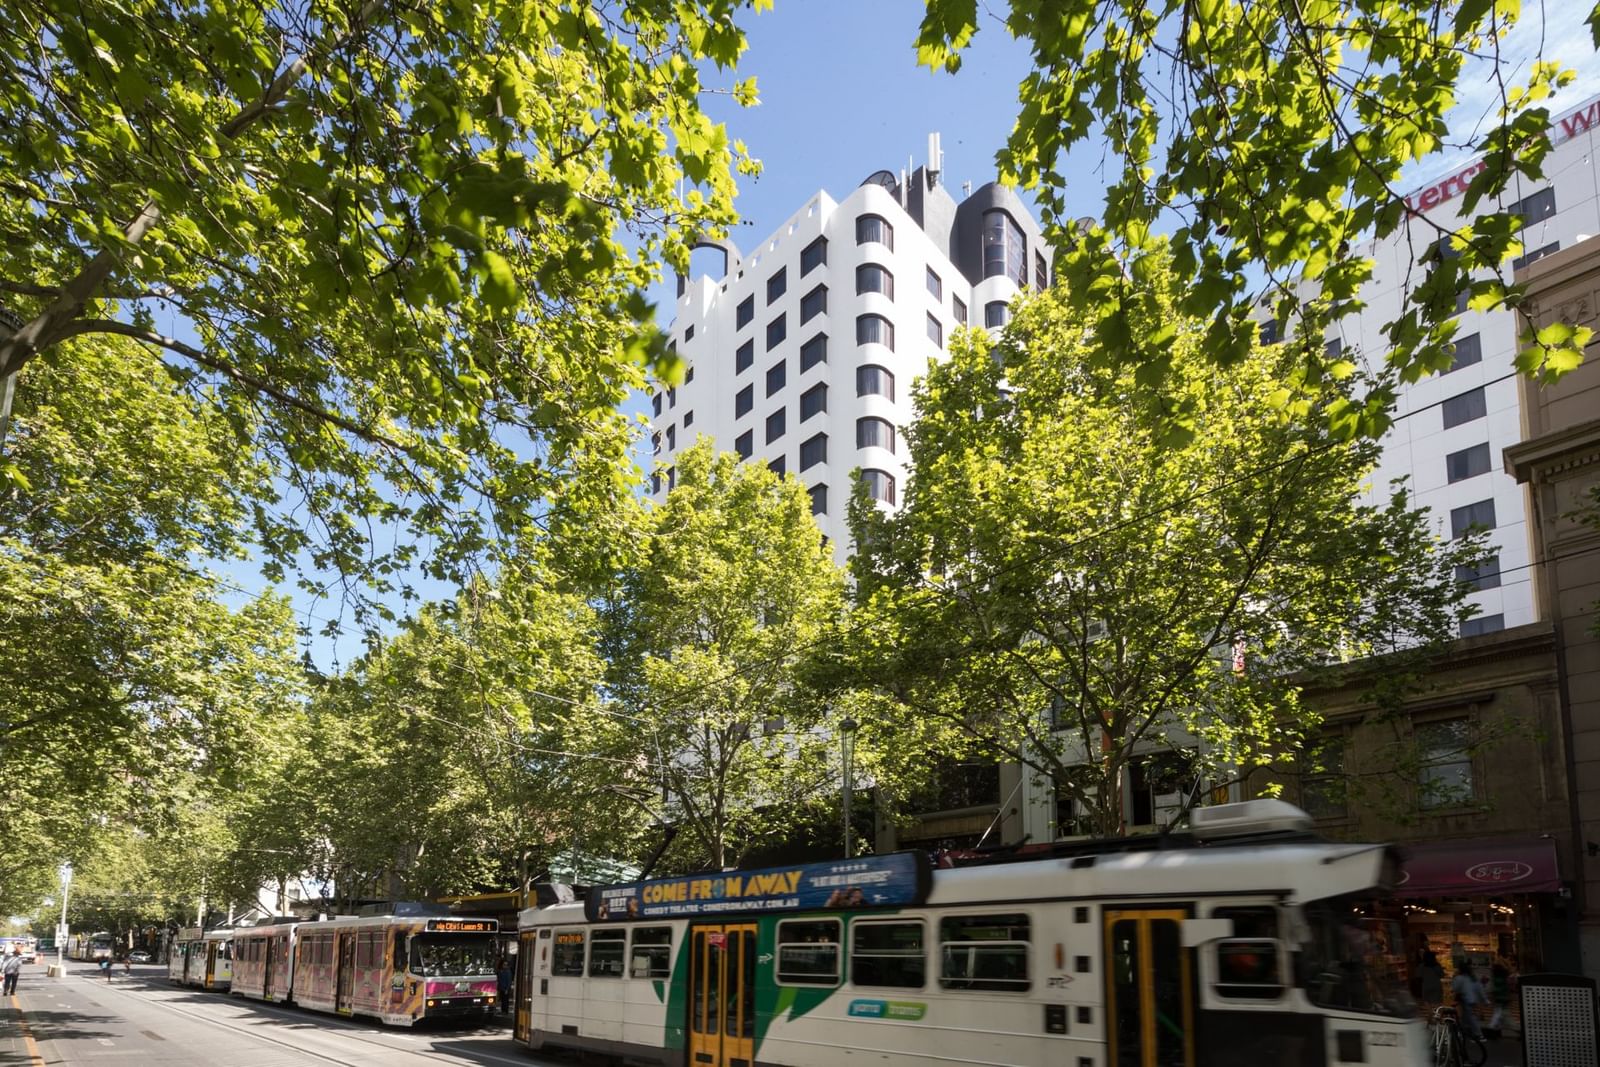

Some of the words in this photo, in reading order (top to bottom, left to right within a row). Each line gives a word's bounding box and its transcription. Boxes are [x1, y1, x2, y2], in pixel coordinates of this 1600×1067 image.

[643, 882, 688, 904] COME
[690, 877, 742, 900] FROM
[743, 871, 803, 896] AWAY
